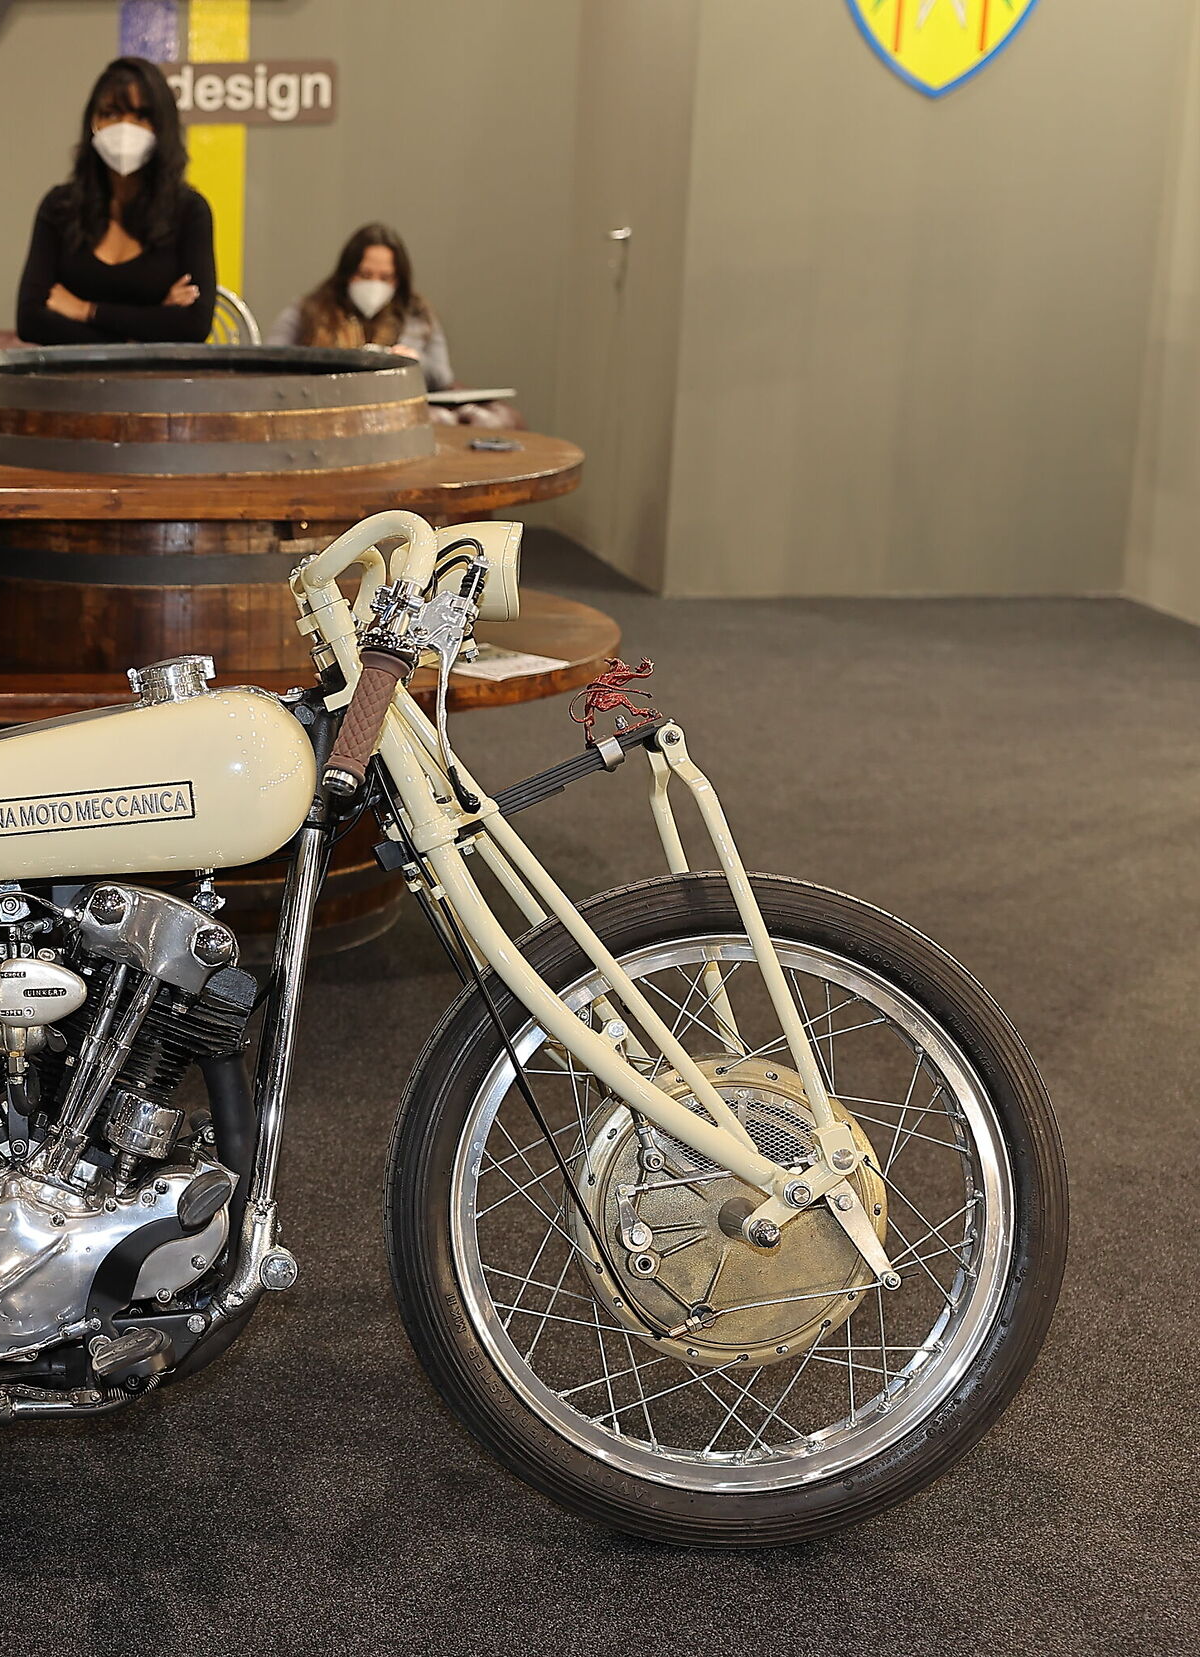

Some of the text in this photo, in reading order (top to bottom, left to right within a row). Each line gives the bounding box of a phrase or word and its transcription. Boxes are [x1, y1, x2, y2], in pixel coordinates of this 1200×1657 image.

[167, 63, 332, 121] design
[20, 801, 73, 826] MOTO
[76, 790, 188, 822] MECCANICA
[467, 1345, 572, 1464] SPEEDMASTER
